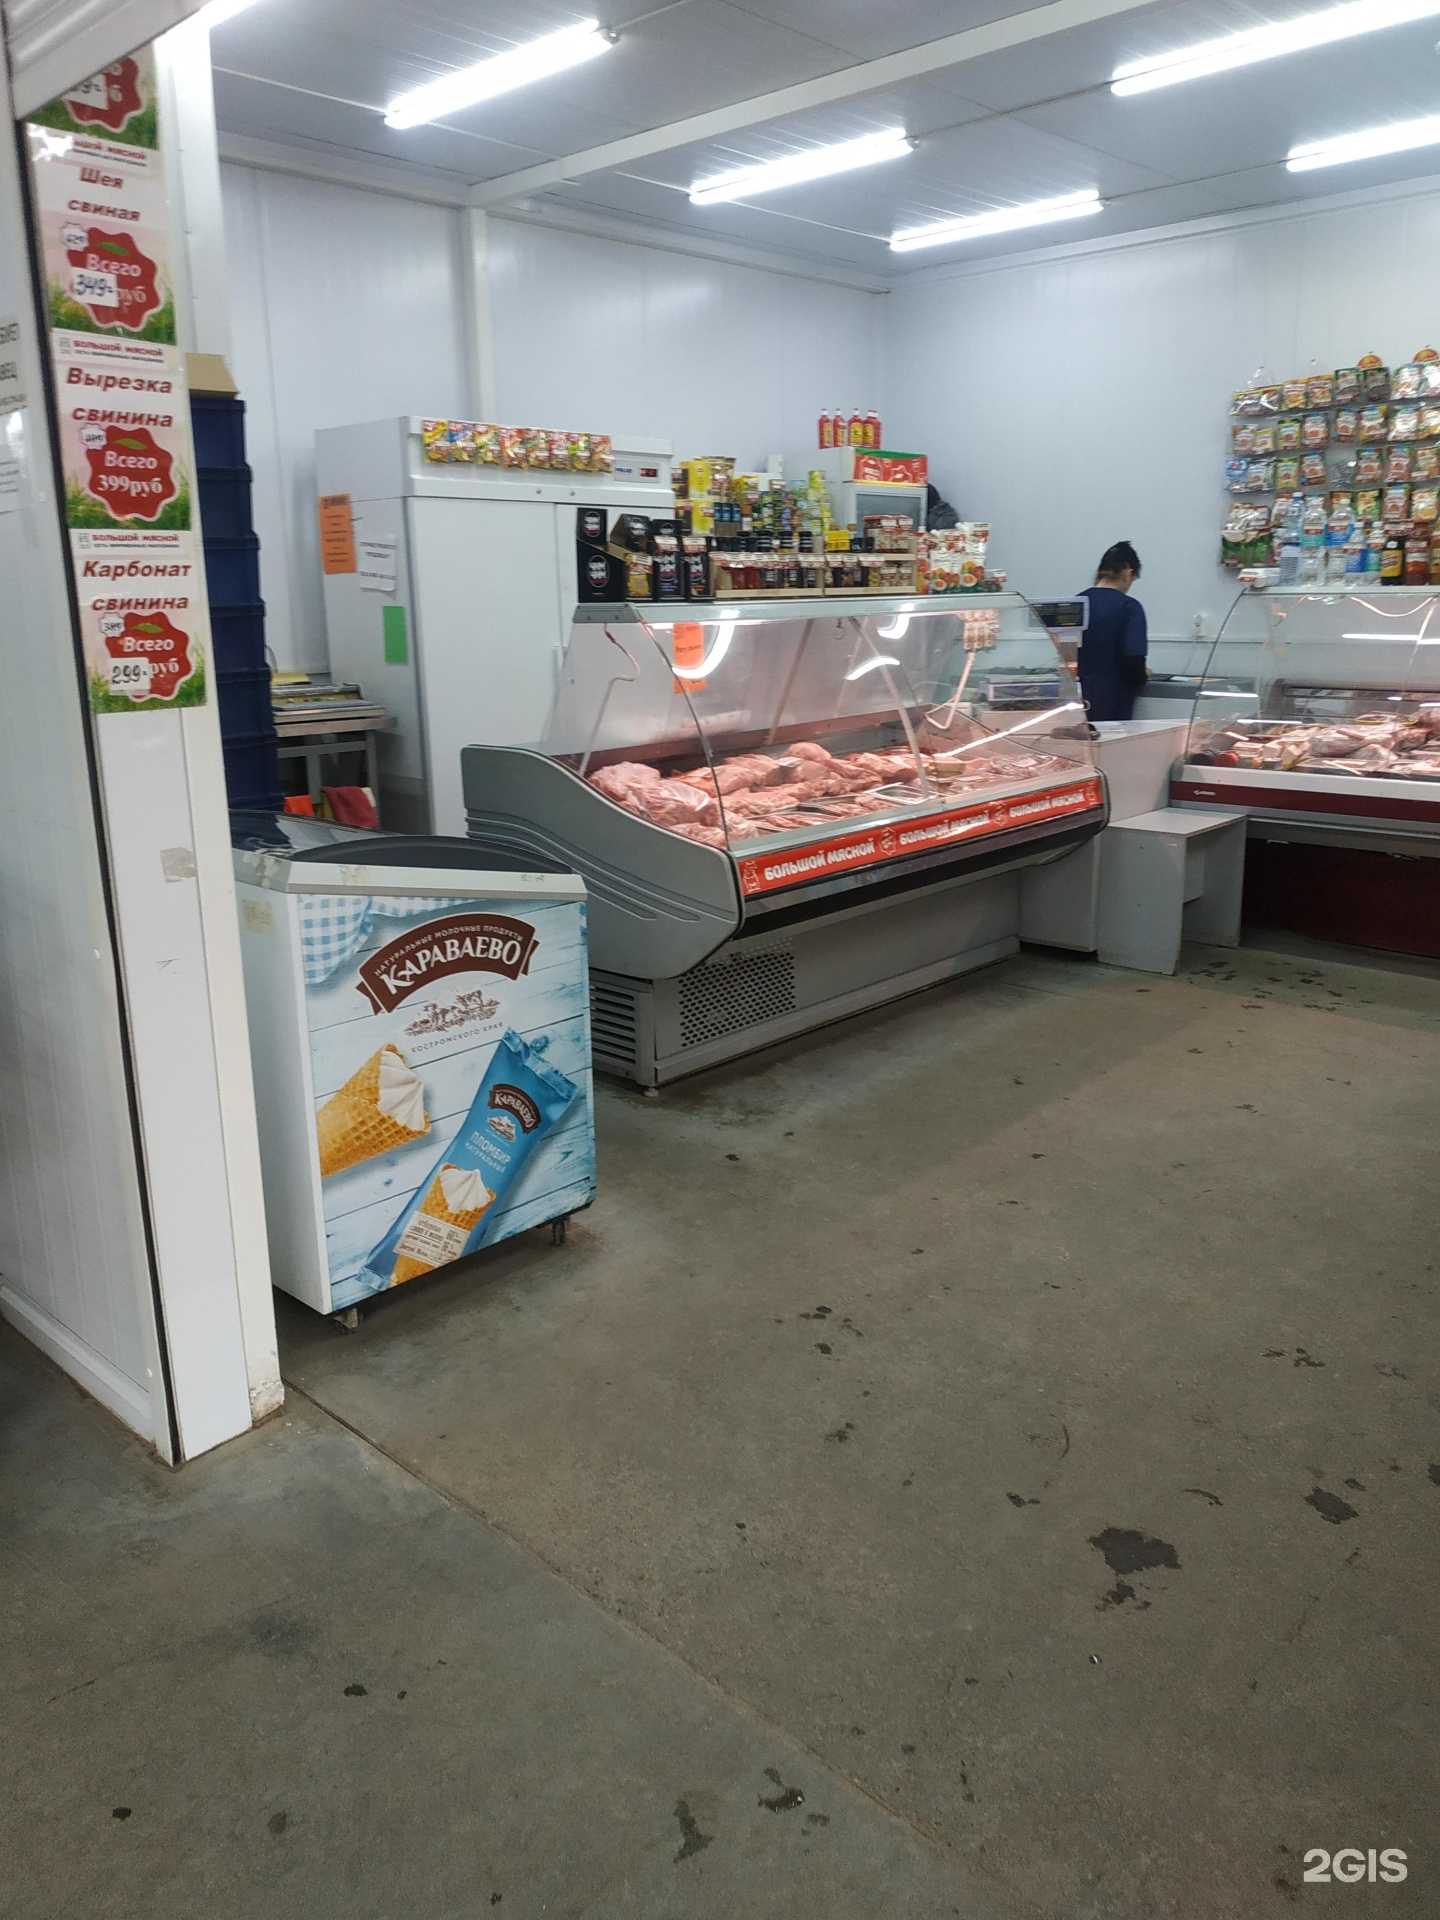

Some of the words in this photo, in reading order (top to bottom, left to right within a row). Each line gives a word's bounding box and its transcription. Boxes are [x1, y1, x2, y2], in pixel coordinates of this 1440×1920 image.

[80, 166, 124, 190] Шея
[68, 199, 142, 222] свиная
[86, 252, 142, 277] Всего
[66, 366, 173, 394] Вырезка
[71, 407, 174, 428] свинина
[104, 450, 159, 470] Всего
[96, 474, 163, 498] 399руб
[82, 560, 193, 582] Карбонат
[91, 596, 190, 612] свинина
[123, 636, 175, 653] Всего
[763, 850, 827, 881] БОЛЬШОЙ
[827, 838, 876, 864] МЯСНОЙ
[374, 933, 434, 977] НАТУРАЛЬНЫЕ
[434, 924, 482, 939] МОЛОЧНЫЕ
[482, 924, 524, 942] ПРОДУКТЫ
[379, 935, 522, 995] КАРАВАЕВО
[411, 1027, 481, 1053] КОСТРОМСКОГО
